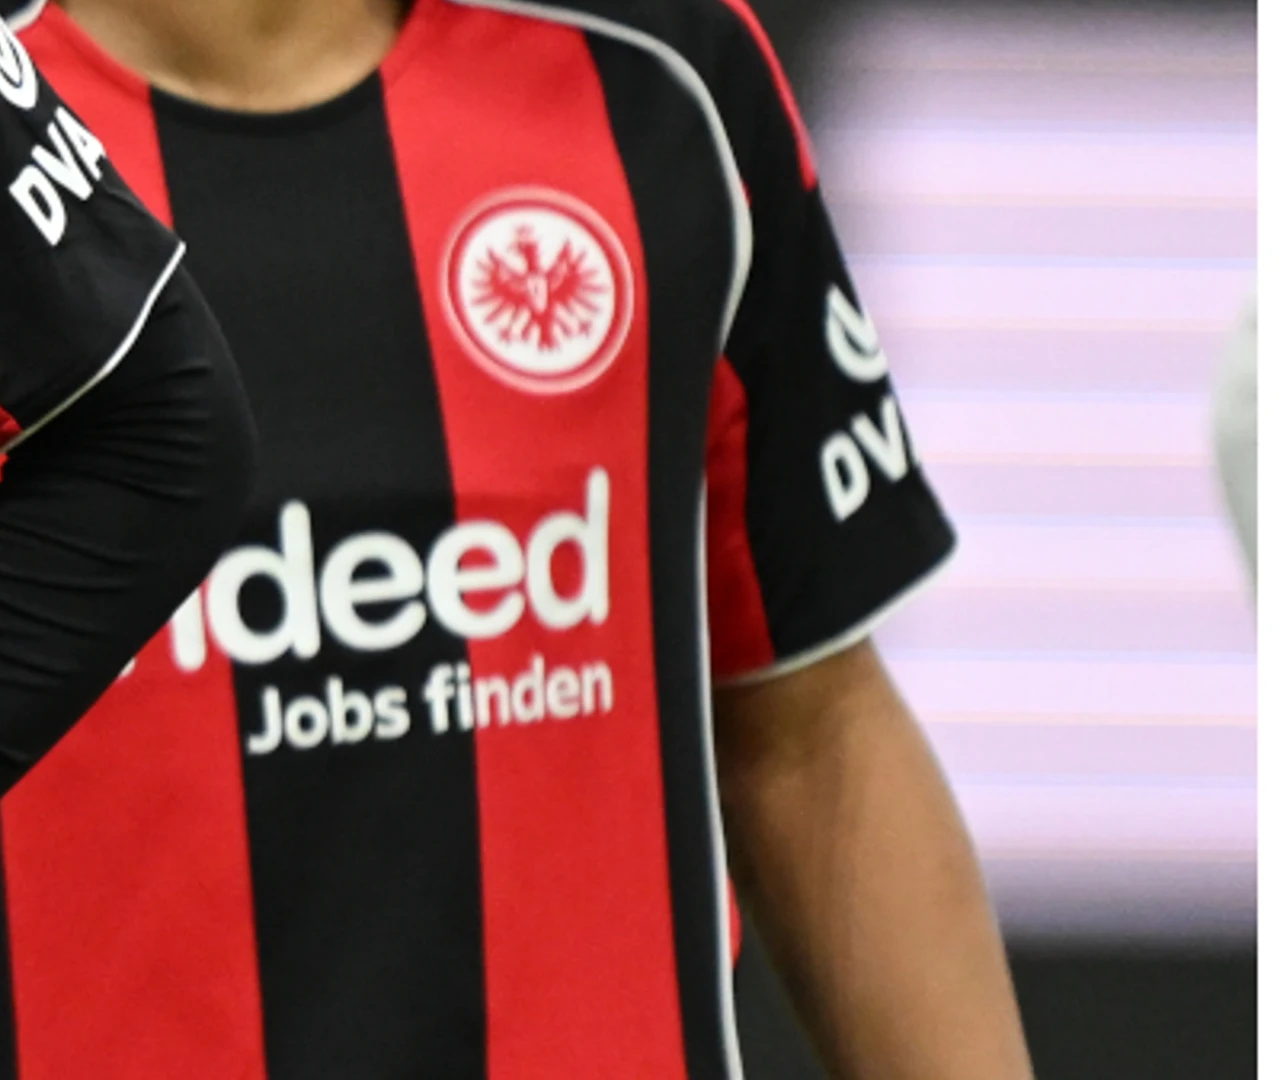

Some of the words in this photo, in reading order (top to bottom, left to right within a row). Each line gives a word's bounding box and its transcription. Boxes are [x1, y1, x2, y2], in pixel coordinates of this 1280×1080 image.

[820, 395, 923, 523] DV
[118, 465, 611, 680] deed
[246, 676, 411, 755] Jobs
[423, 654, 614, 734] finden
